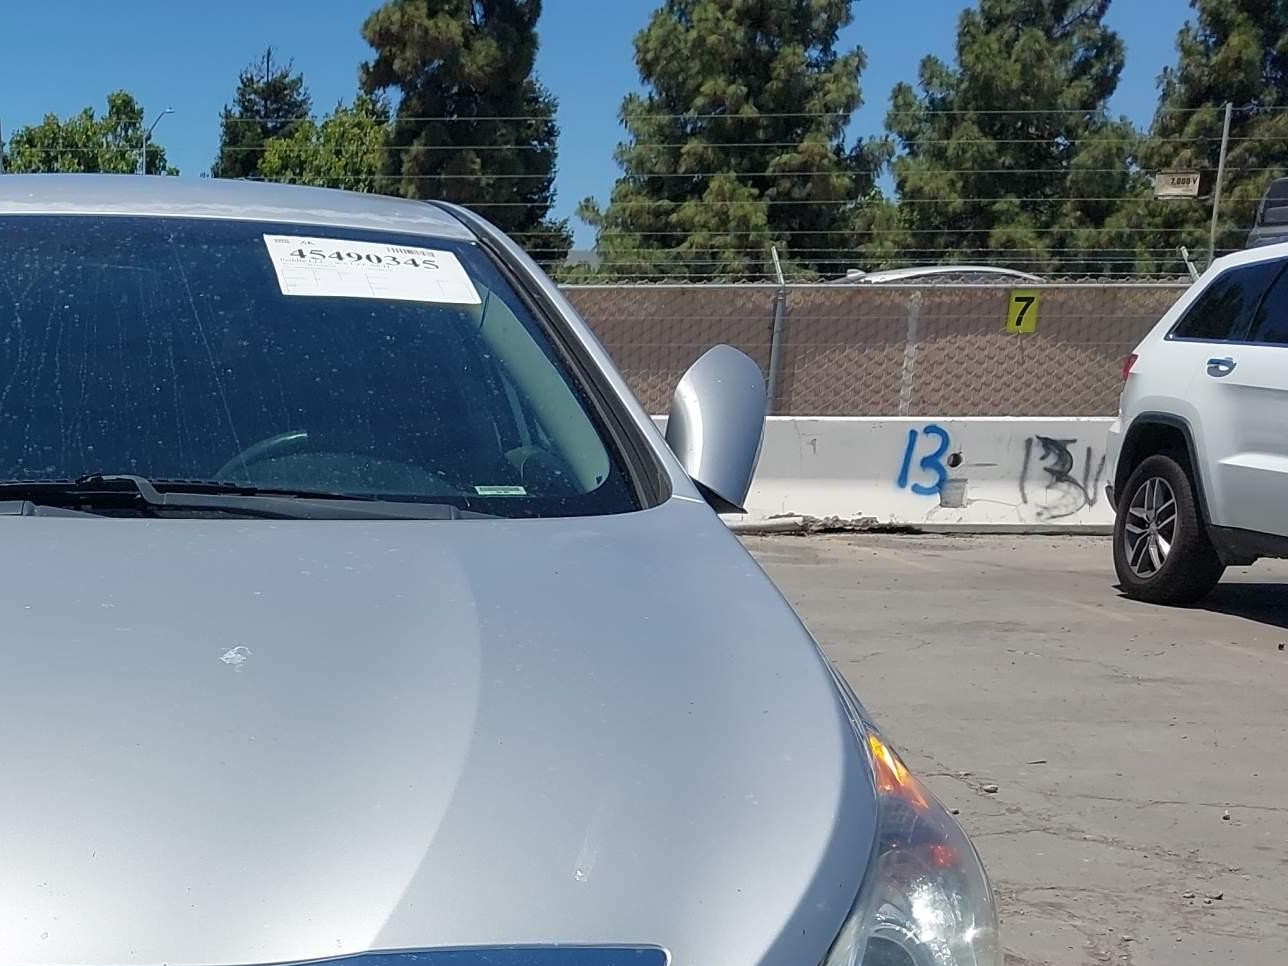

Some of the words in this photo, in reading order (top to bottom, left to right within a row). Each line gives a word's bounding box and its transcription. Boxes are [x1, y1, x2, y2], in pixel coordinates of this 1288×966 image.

[289, 248, 440, 270] 45490345
[1014, 296, 1035, 326] 7
[896, 424, 951, 496] 13
